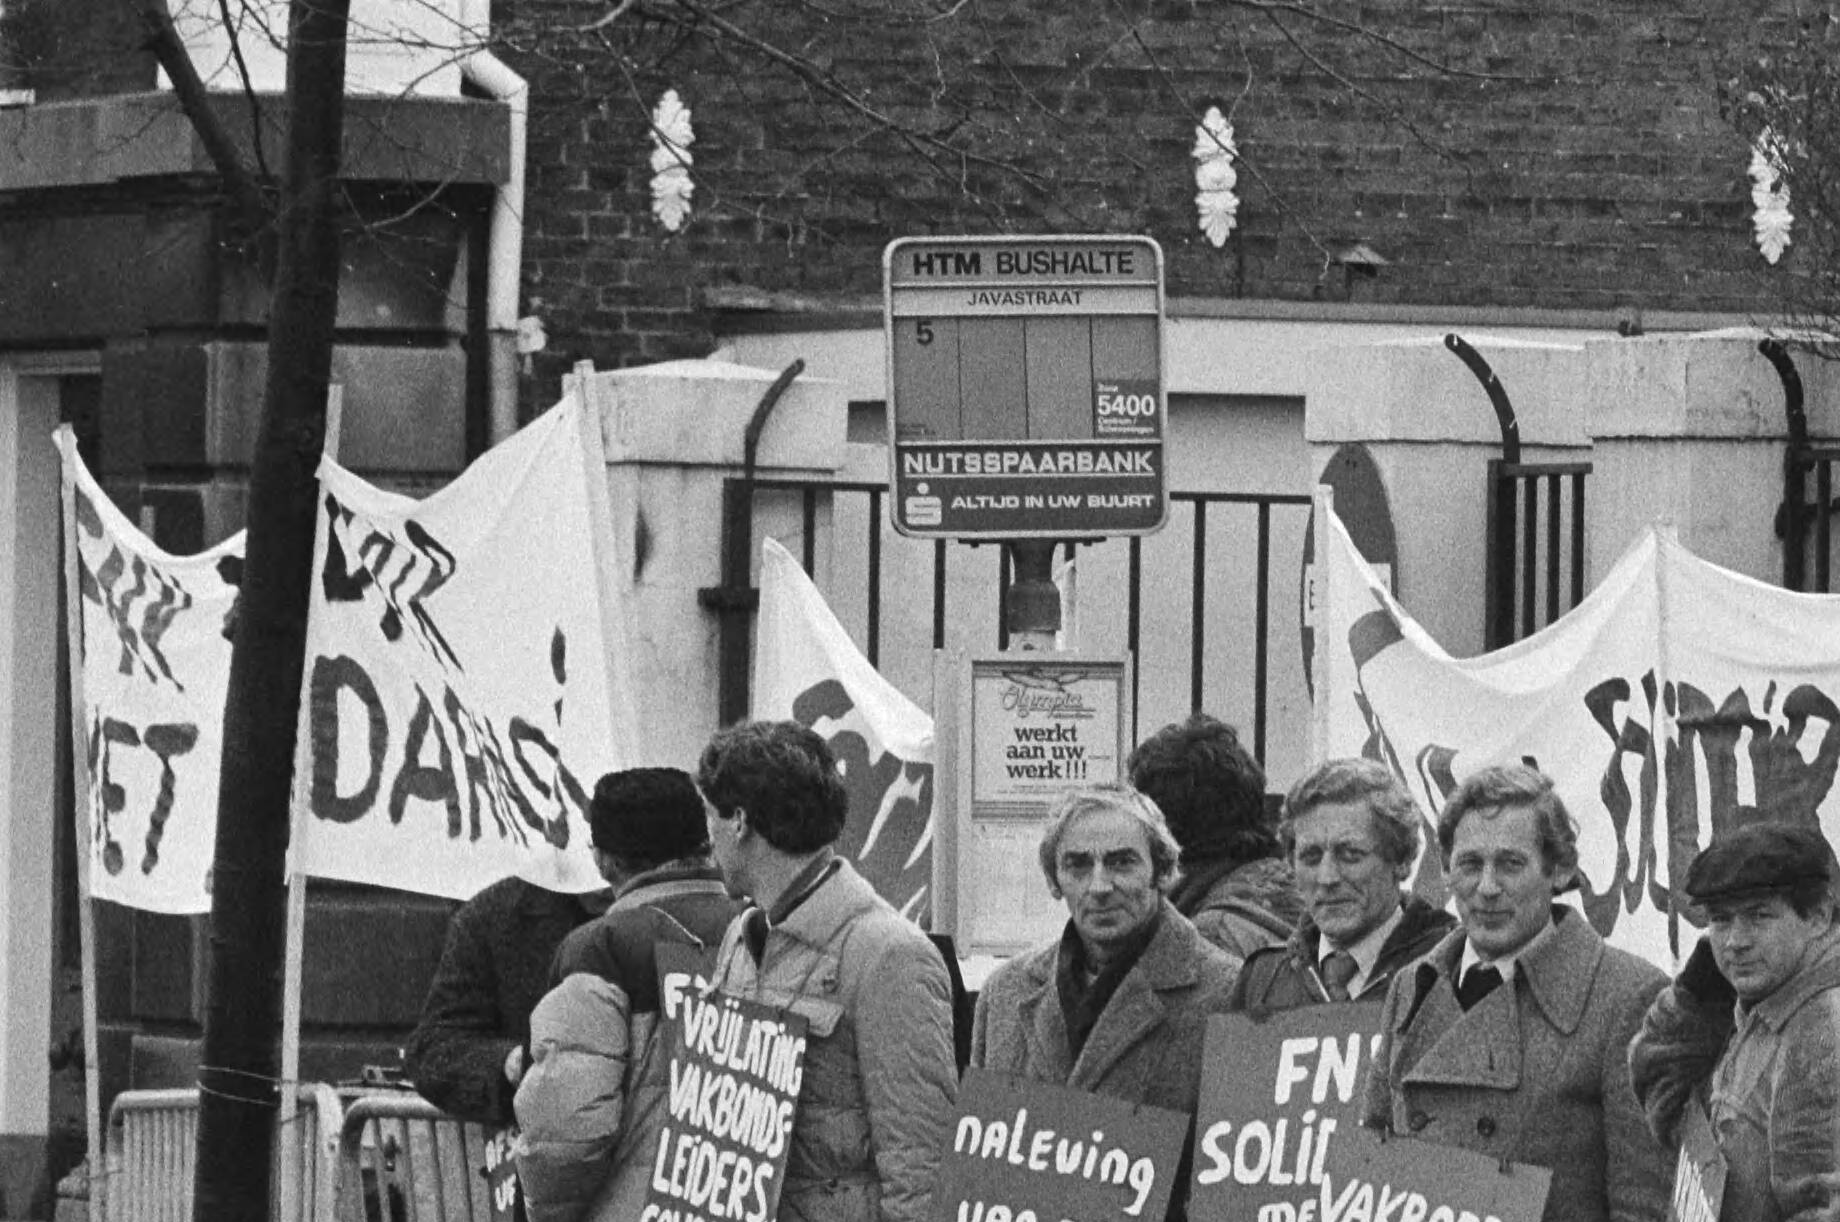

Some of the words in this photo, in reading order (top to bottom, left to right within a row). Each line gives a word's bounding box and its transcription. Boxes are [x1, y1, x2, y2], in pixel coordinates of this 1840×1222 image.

[913, 252, 982, 276] HTM
[996, 250, 1135, 275] BUSHALTE
[967, 290, 1084, 306] JAVASTRAAT
[916, 321, 934, 346] 5
[1097, 394, 1155, 416] 5400
[904, 451, 1154, 474] NUTSSPAARBANK
[950, 494, 1020, 509] ALTIJD
[1024, 494, 1045, 508] IN
[1047, 494, 1082, 509] UW
[1086, 494, 1155, 508] BUURT
[1013, 723, 1078, 742] werkt
[1006, 745, 1046, 760] aan
[1051, 746, 1085, 760] uw
[1274, 1032, 1383, 1105] FN
